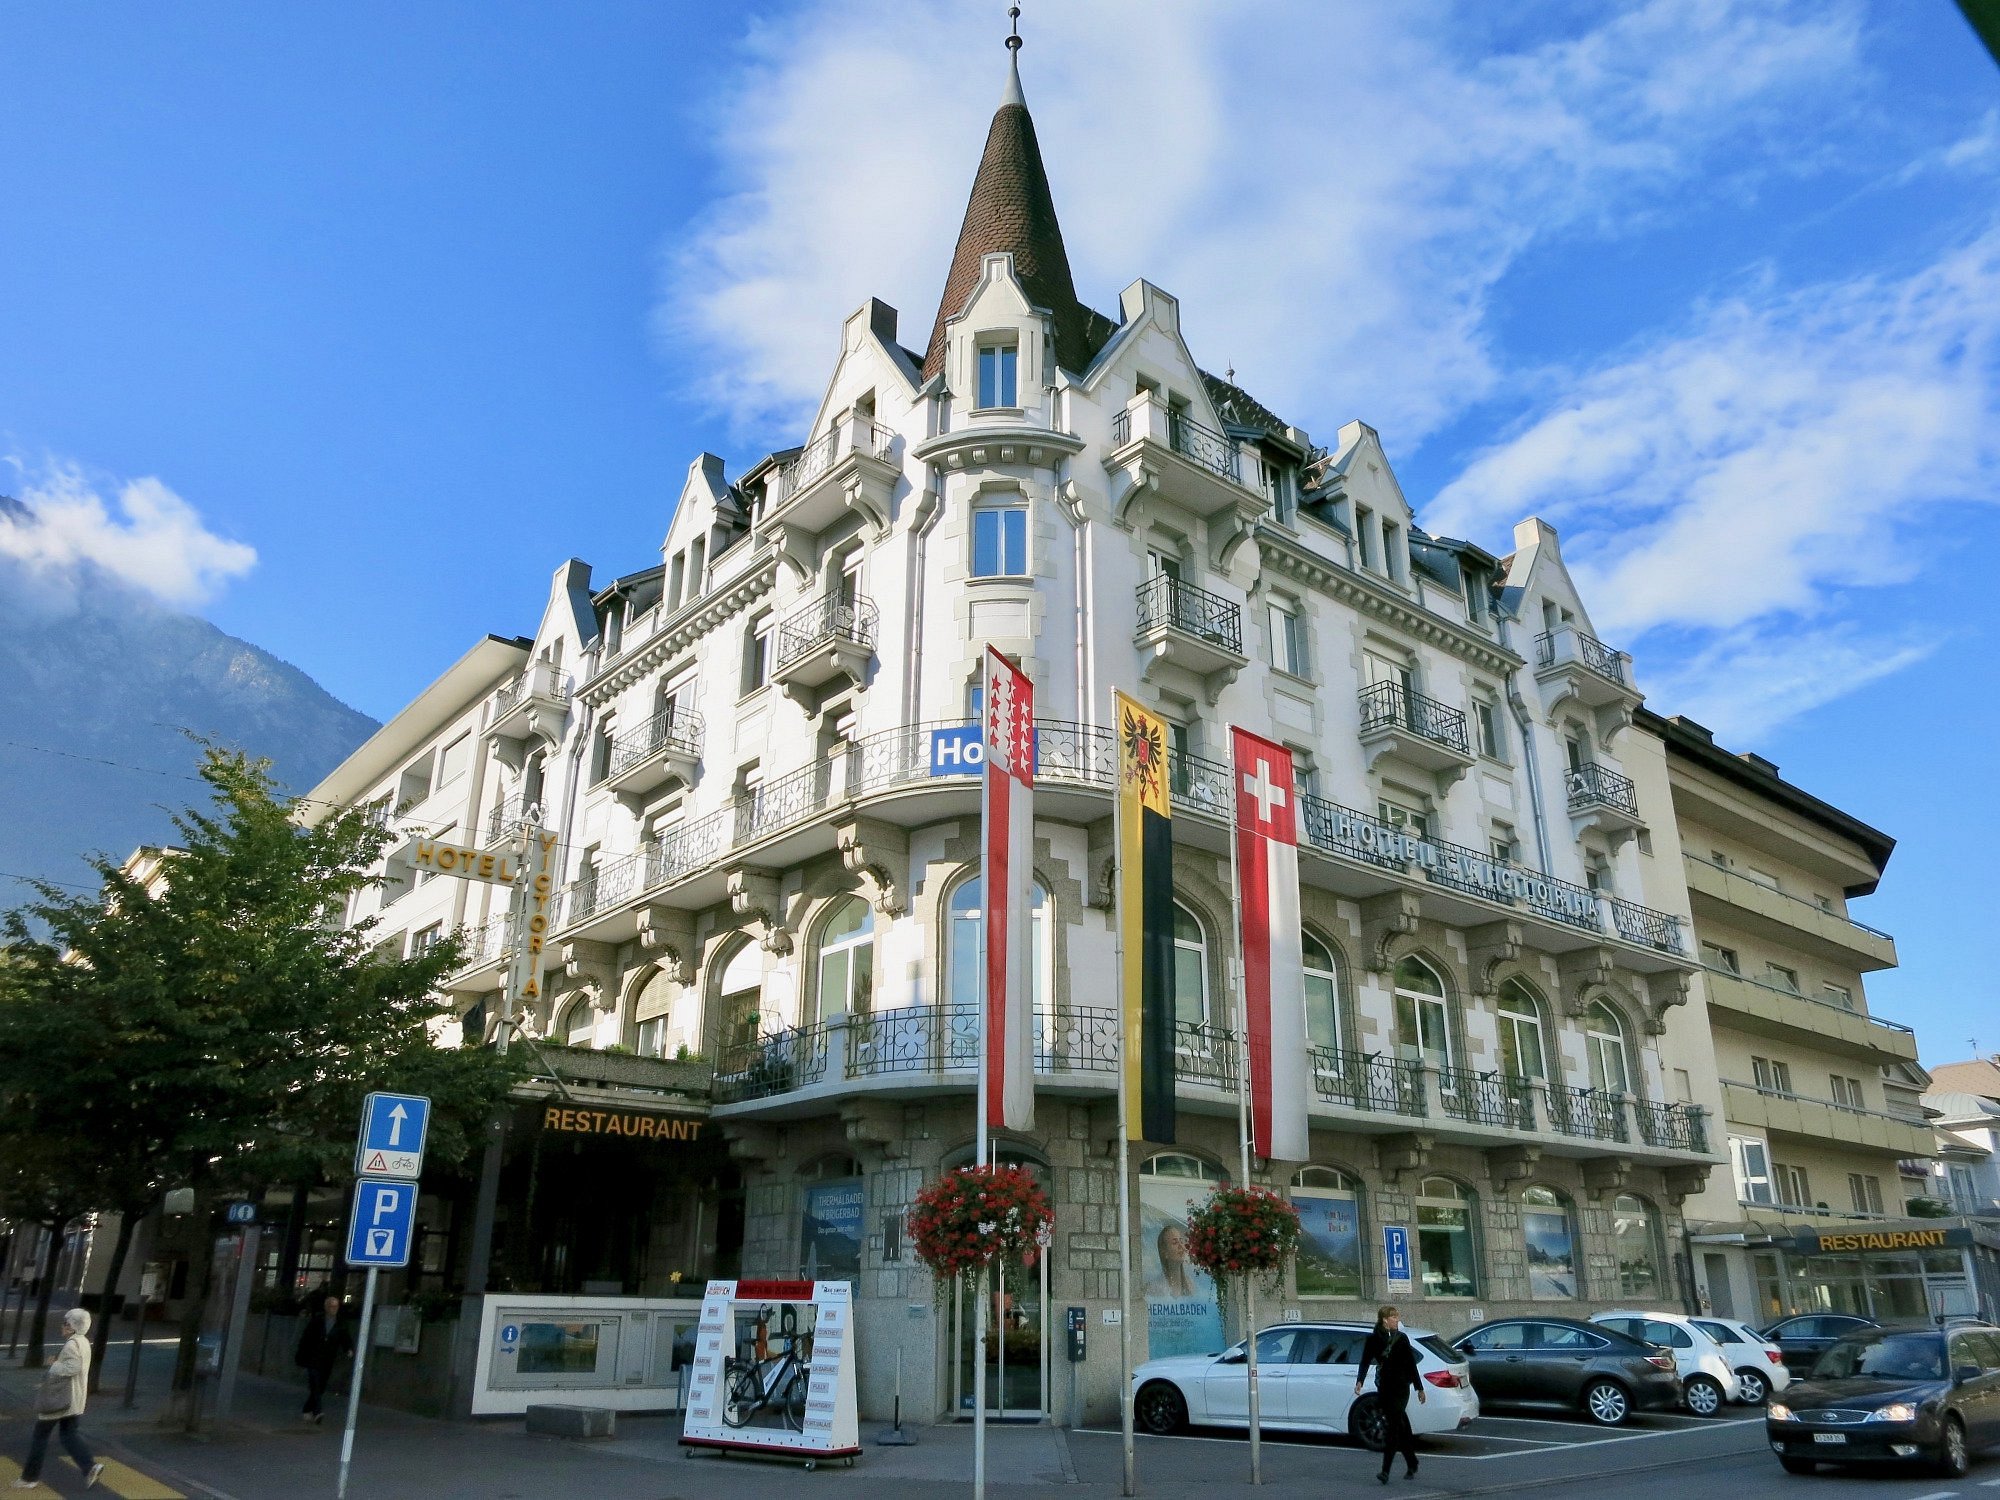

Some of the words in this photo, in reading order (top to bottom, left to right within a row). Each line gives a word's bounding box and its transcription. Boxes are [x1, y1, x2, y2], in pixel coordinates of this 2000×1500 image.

[415, 842, 515, 881] HOTEL
[1334, 814, 1437, 868] HOTEL
[1459, 856, 1599, 917] VICTORIA
[521, 832, 557, 998] VICTORIA
[544, 1107, 702, 1141] RESTAURANT
[373, 1189, 399, 1225] P
[1392, 1232, 1401, 1252] P
[1819, 1230, 1947, 1251] RESTAURANT
[1148, 1303, 1207, 1315] HERMALBADEN
